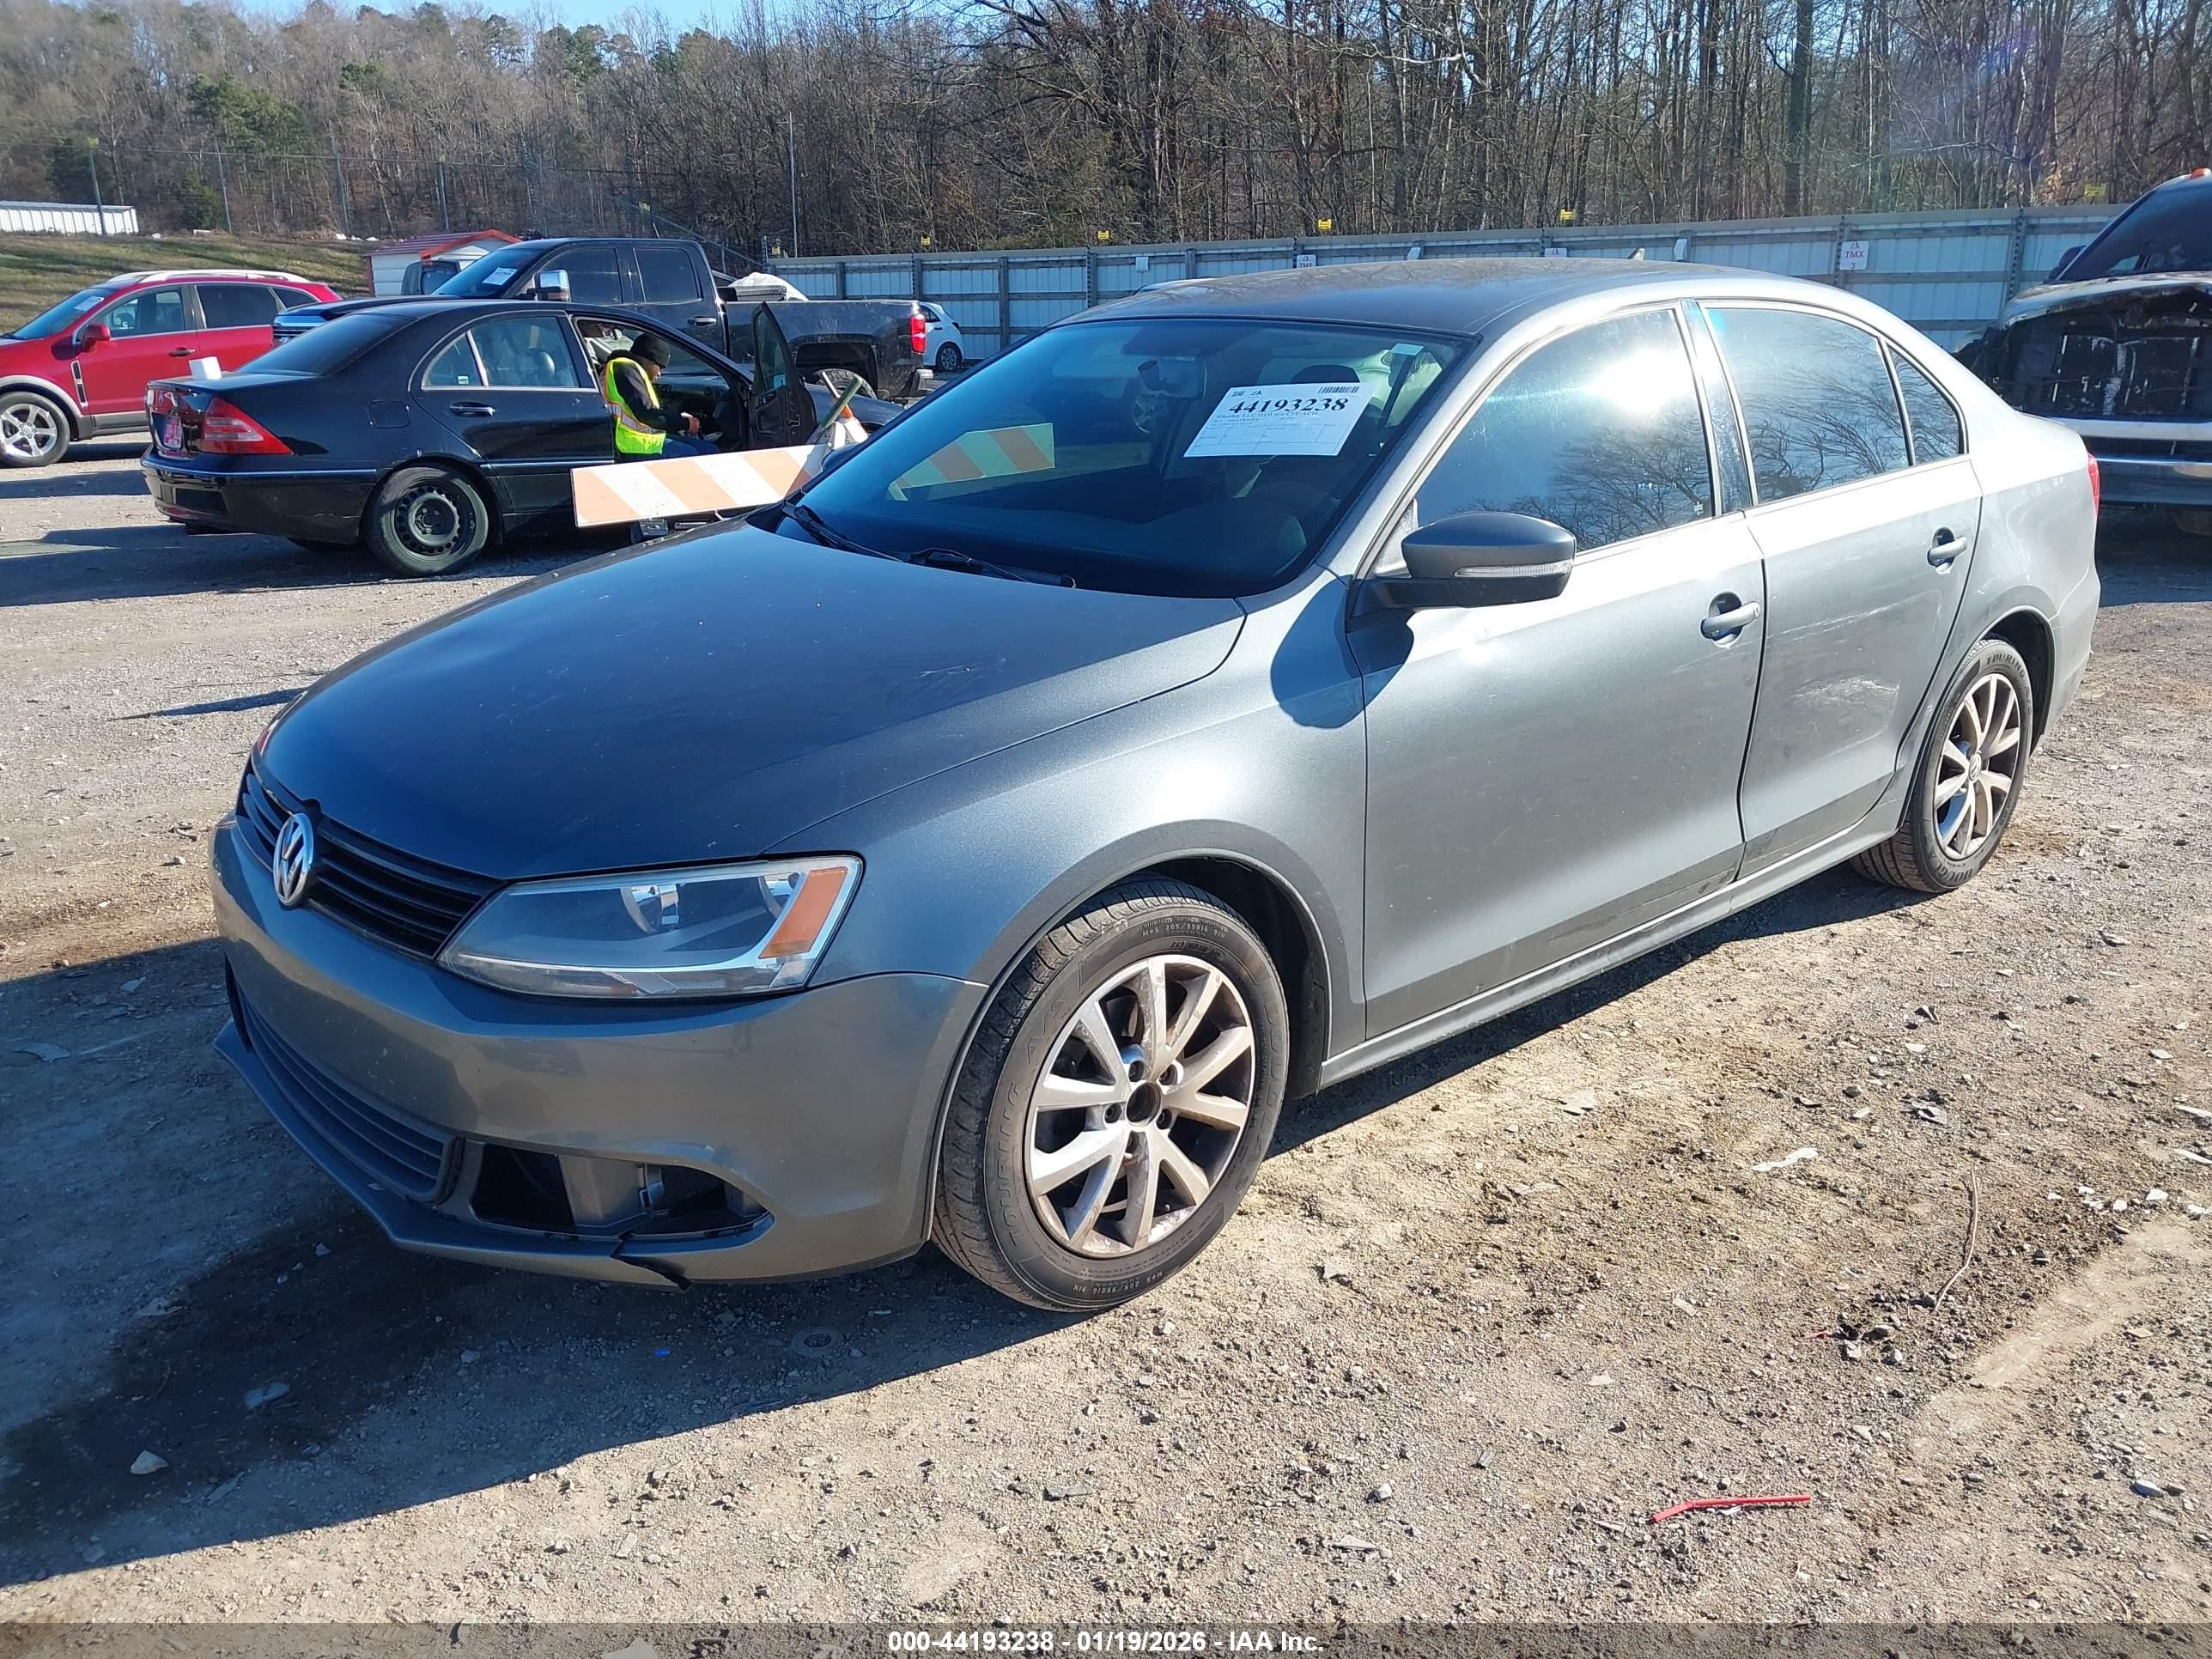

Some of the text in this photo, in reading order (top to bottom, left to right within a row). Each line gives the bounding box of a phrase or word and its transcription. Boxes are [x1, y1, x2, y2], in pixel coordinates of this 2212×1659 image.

[1229, 398, 1349, 414] 44193238
[273, 812, 314, 906] VW
[1165, 922, 1208, 933] 205/55R16
[996, 1079, 1020, 1246] TOURING
